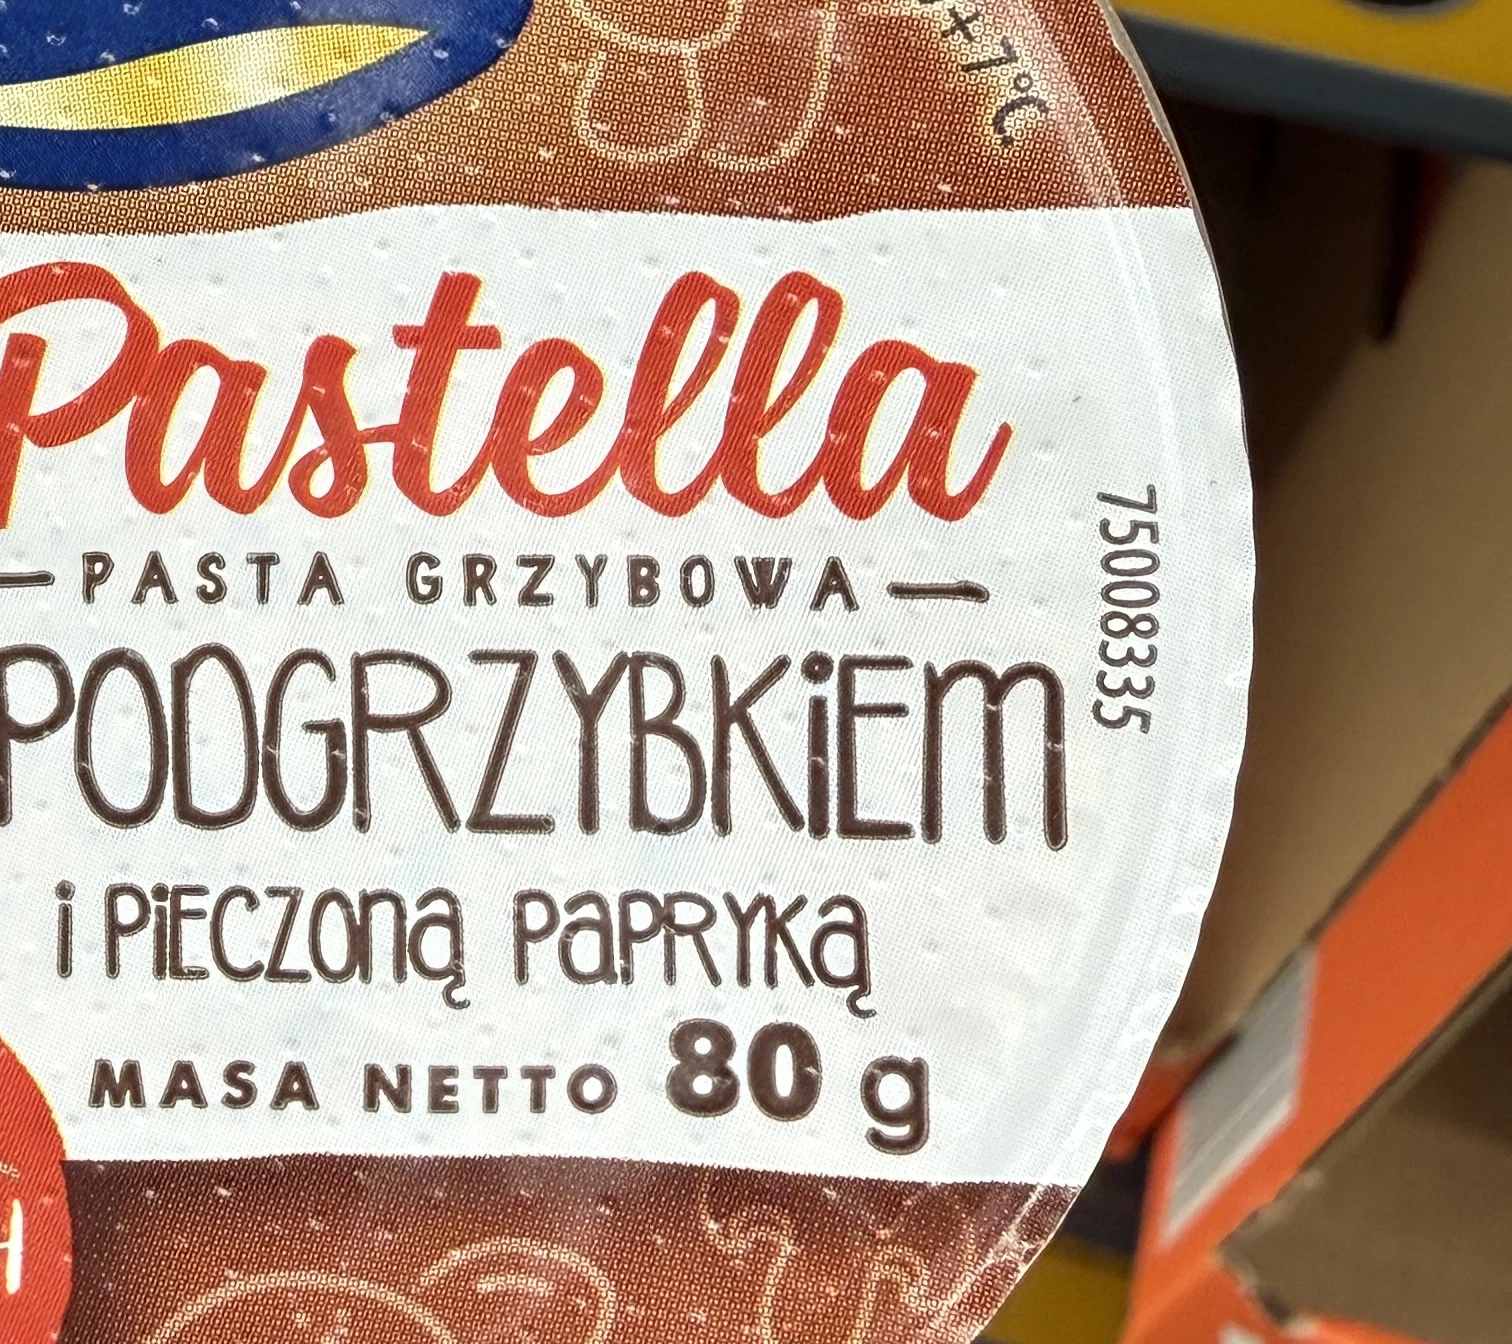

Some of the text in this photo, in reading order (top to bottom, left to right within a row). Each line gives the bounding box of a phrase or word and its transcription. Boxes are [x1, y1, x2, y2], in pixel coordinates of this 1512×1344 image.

[81, 550, 861, 613] PASTA GRZYBOWA
[1092, 483, 1161, 735] 75008335
[54, 879, 76, 979] i
[88, 1018, 931, 1156] MASA NETTO 80 g
